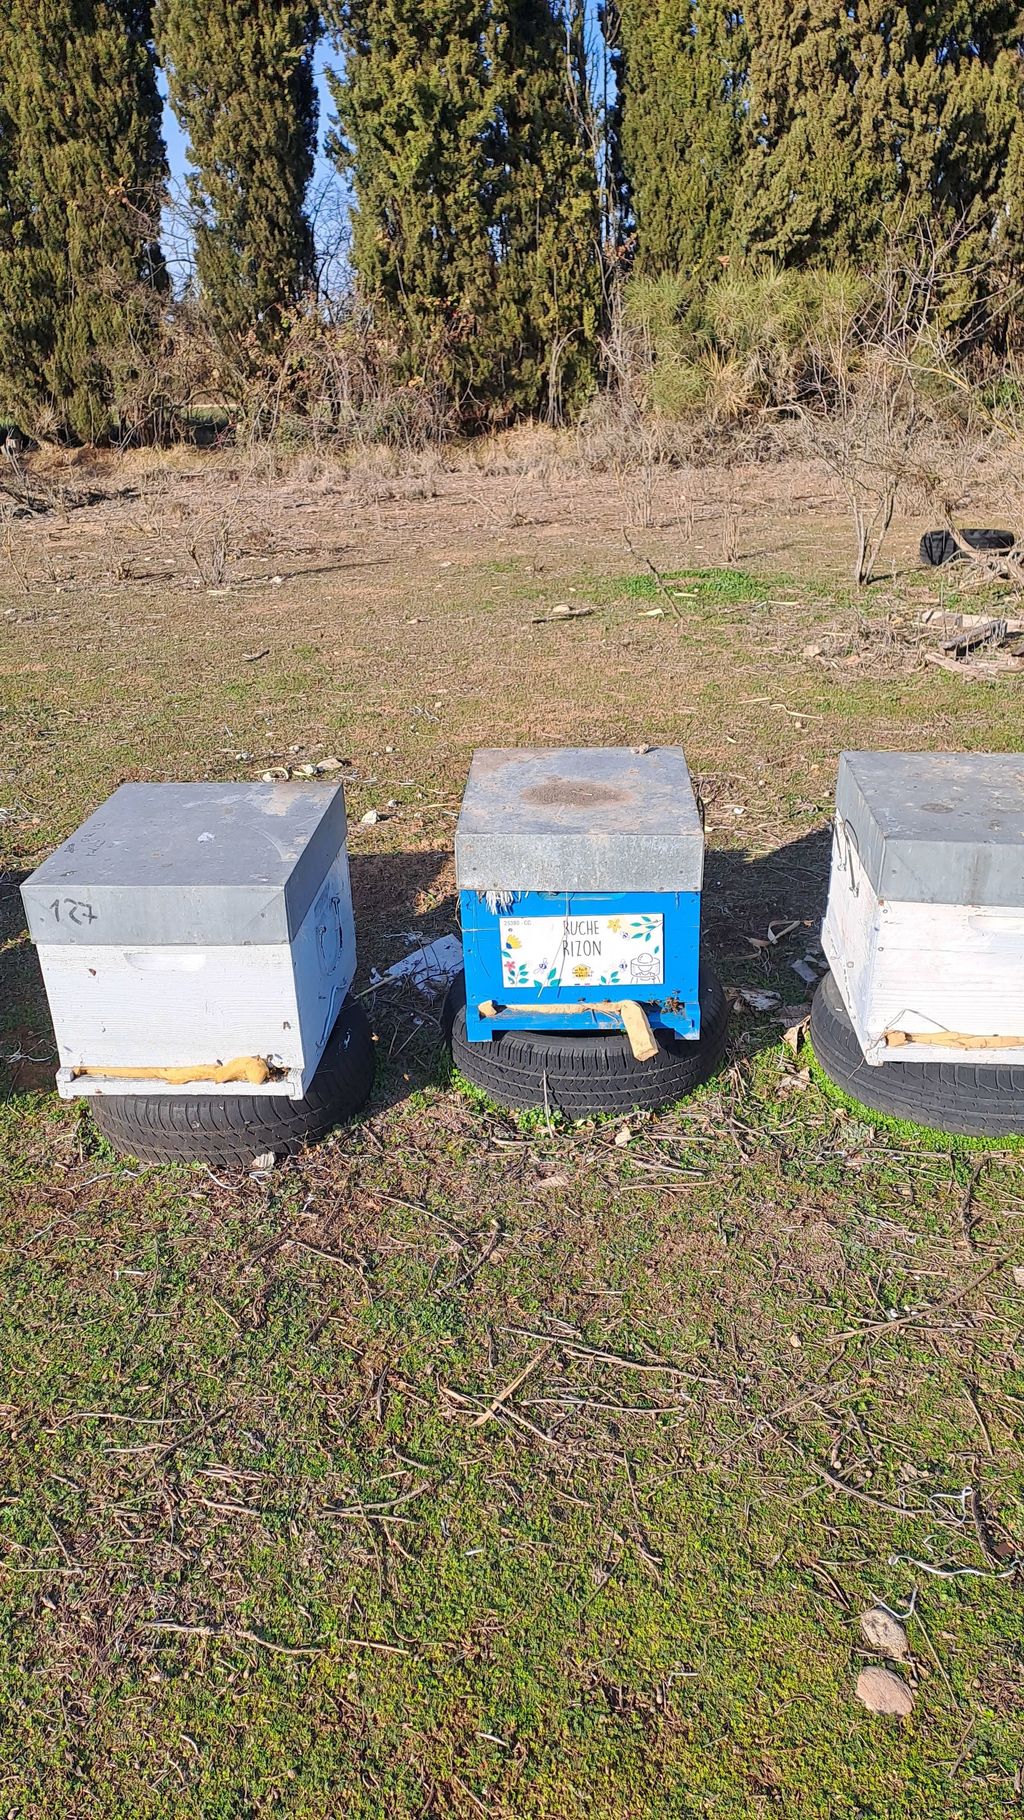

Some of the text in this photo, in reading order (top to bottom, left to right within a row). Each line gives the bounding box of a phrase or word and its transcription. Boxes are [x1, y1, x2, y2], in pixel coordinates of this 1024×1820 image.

[49, 898, 98, 926] 127
[563, 920, 600, 936] RUCHE
[562, 938, 602, 958] RIZON
